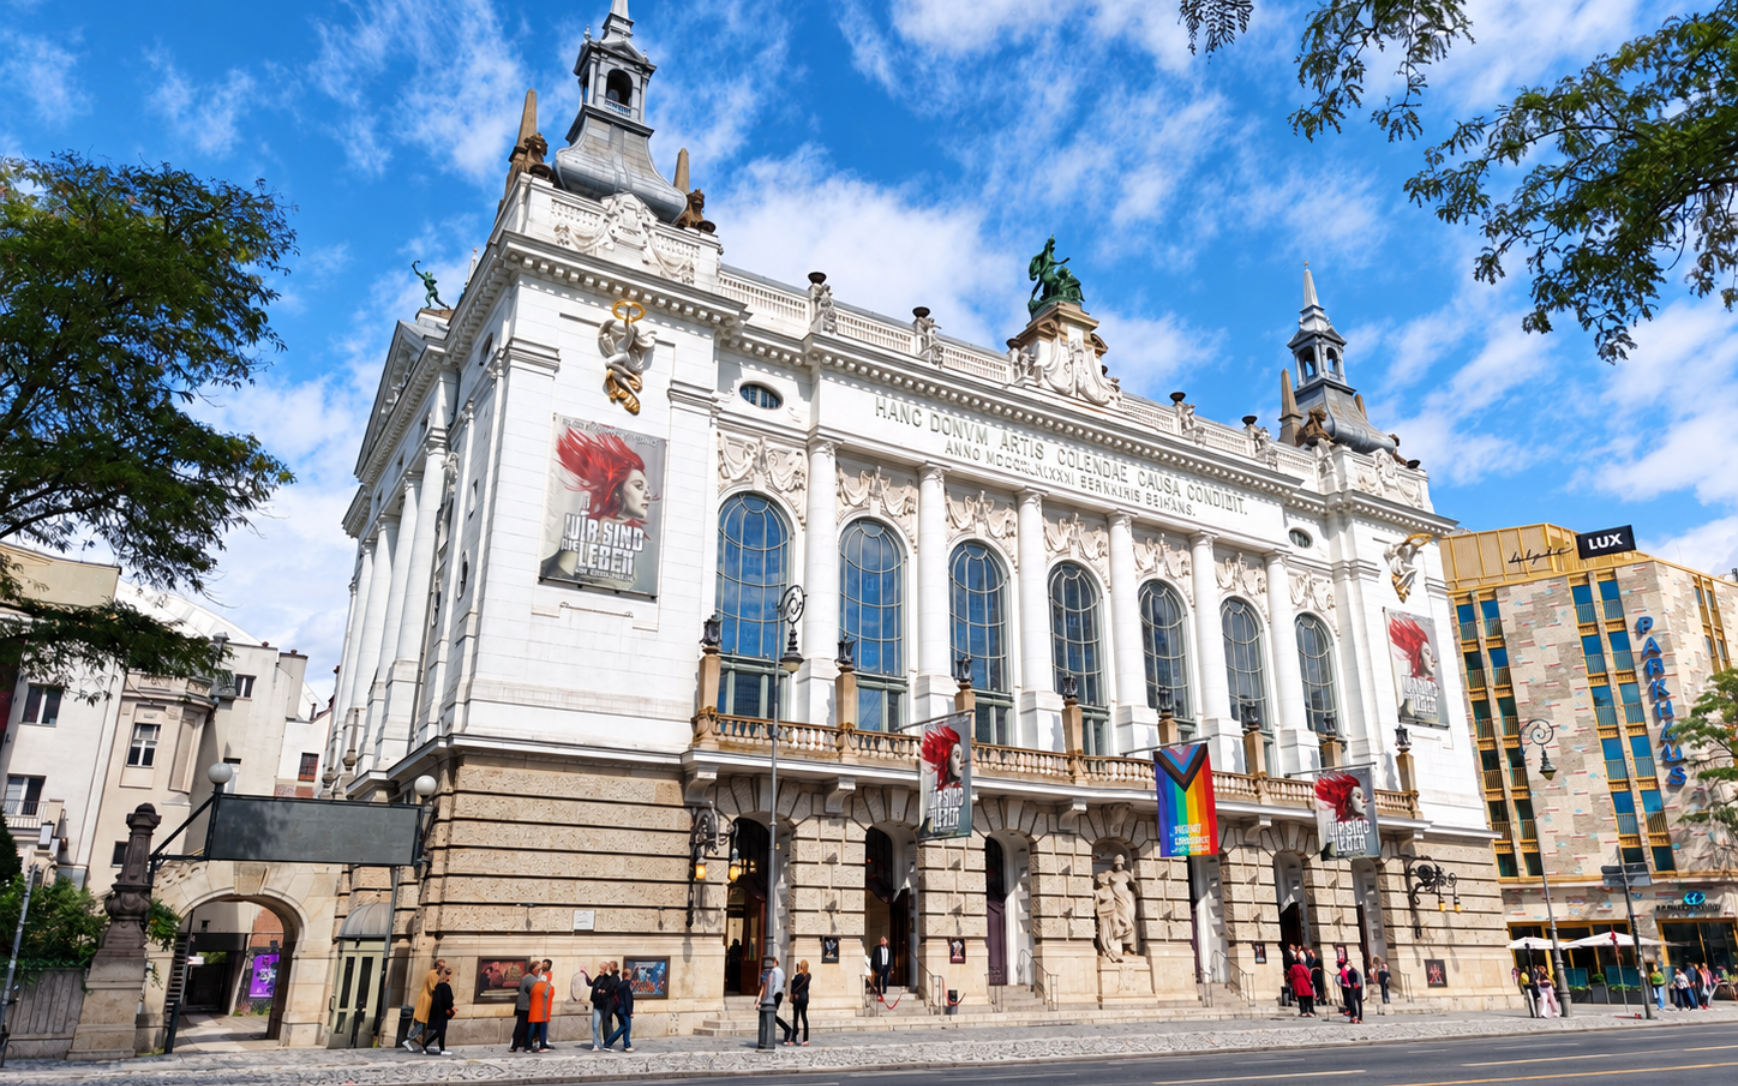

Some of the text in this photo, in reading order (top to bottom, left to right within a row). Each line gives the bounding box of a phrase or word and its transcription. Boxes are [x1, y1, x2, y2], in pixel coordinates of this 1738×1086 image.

[875, 397, 922, 427] HANC
[930, 414, 988, 446] DONVM
[1000, 432, 1044, 460] ARTIS
[1057, 448, 1128, 483] COLENDAE
[1138, 470, 1181, 497] CAUSA
[945, 440, 981, 461] ANNO
[1588, 533, 1623, 550] LUX
